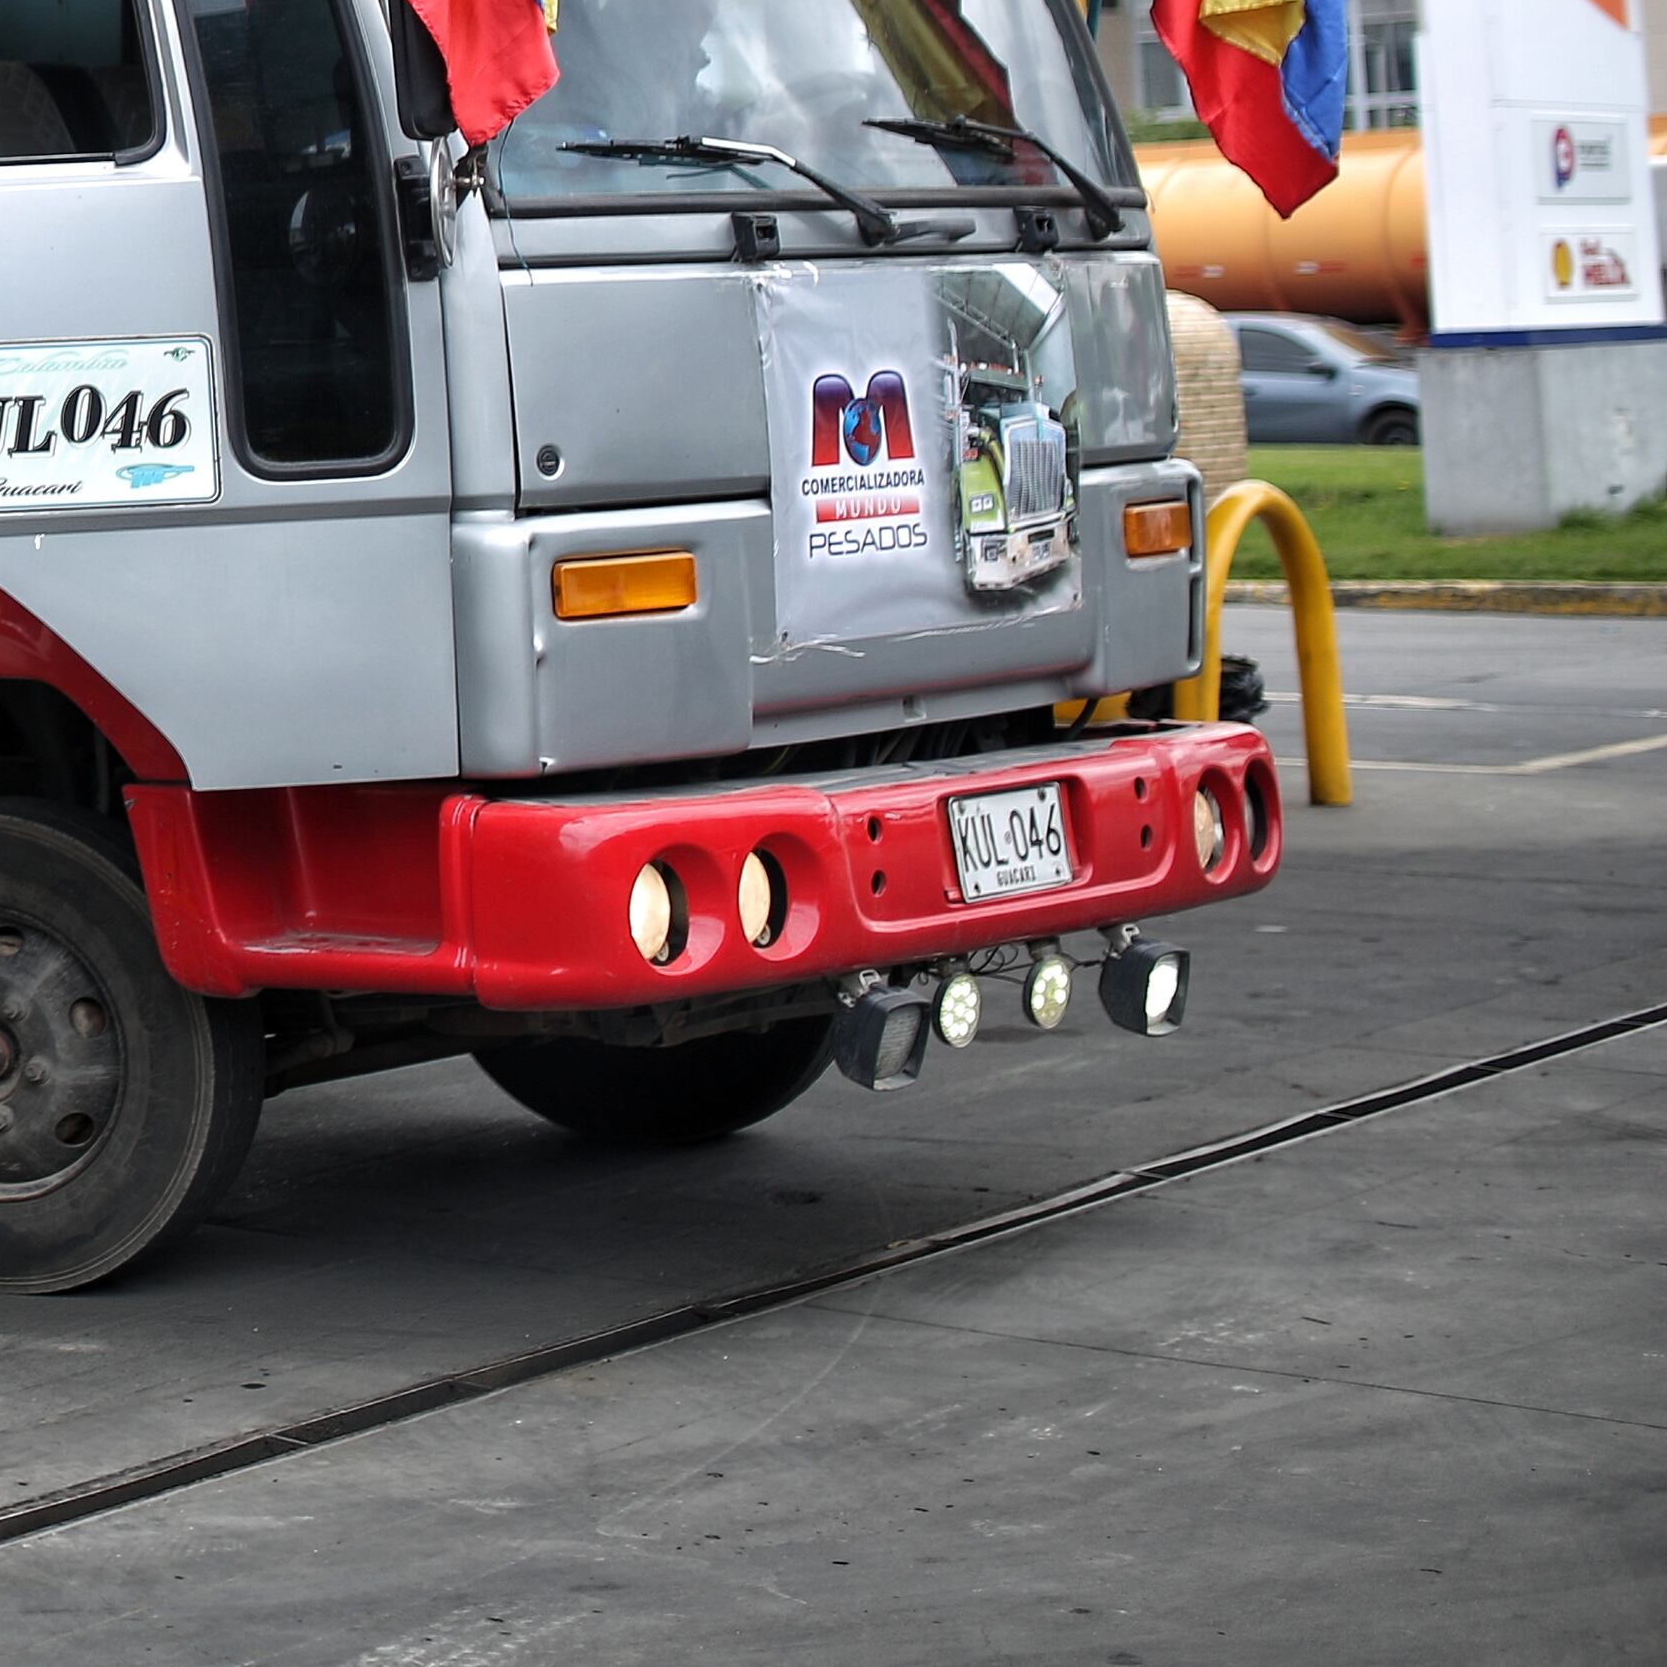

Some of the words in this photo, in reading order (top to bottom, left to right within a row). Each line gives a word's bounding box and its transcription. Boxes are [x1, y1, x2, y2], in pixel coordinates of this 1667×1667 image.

[801, 469, 925, 496] COMERCIALIZADORA
[835, 496, 902, 520] MUNDO
[809, 523, 928, 559] PESADOS
[957, 812, 1009, 873] KUL
[1009, 802, 1062, 862] 046
[996, 865, 1036, 887] GUACARI
